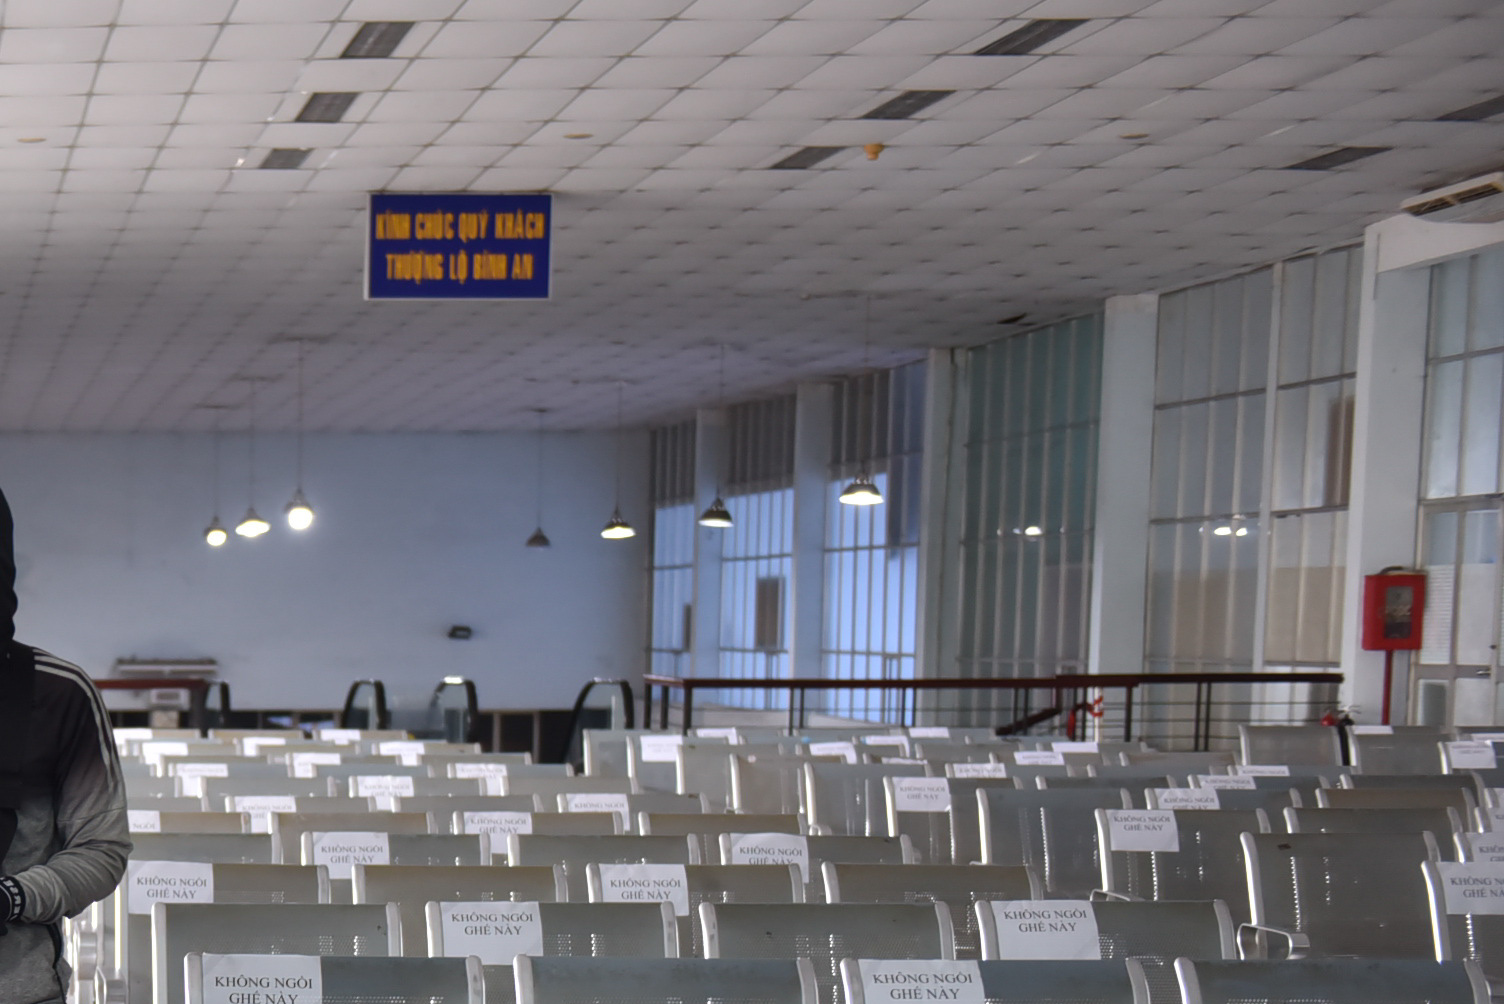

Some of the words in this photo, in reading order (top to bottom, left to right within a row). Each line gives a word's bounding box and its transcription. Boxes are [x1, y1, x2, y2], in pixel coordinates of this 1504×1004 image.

[511, 253, 534, 280] AN
[215, 974, 270, 988] KHÔNG
[872, 971, 929, 984] KHÔNG
[265, 990, 298, 1004] NÀY
[927, 985, 960, 1000] NÀY
